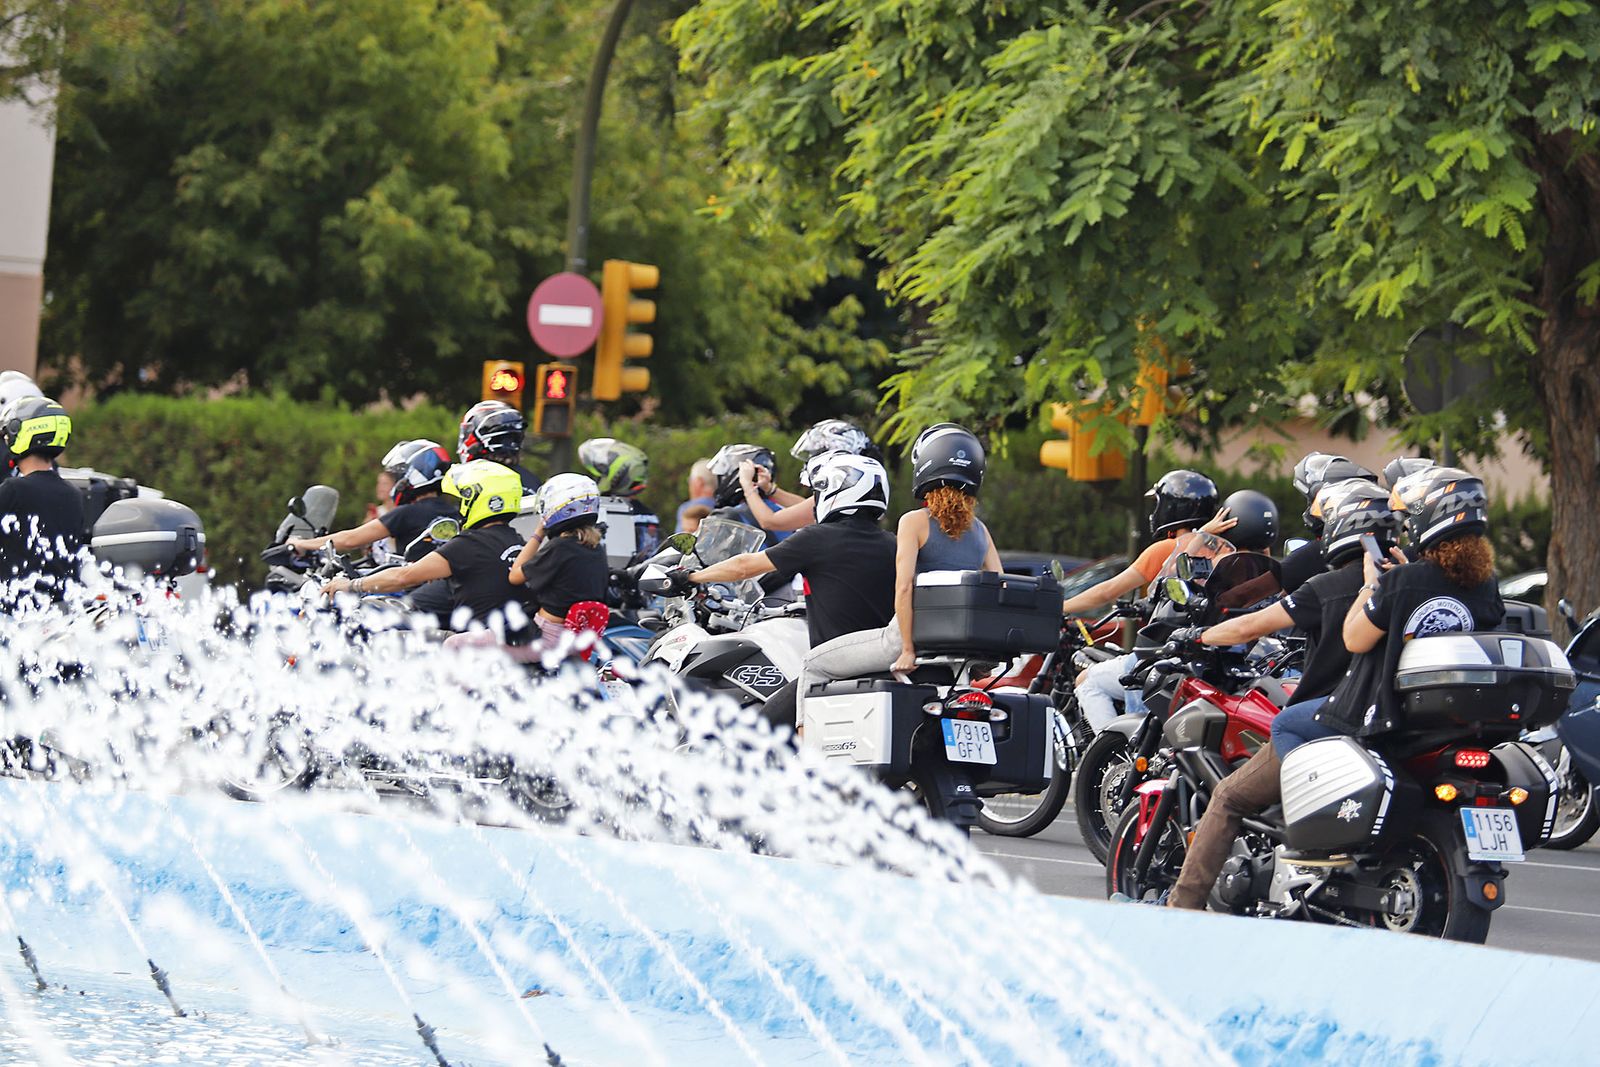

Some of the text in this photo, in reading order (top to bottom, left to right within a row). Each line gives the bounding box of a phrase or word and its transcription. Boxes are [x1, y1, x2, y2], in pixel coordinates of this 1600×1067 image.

[731, 665, 784, 687] GS
[954, 723, 990, 743] 7918
[958, 741, 983, 760] GFY
[1475, 813, 1513, 832] 1156
[1478, 833, 1509, 851] LJH
